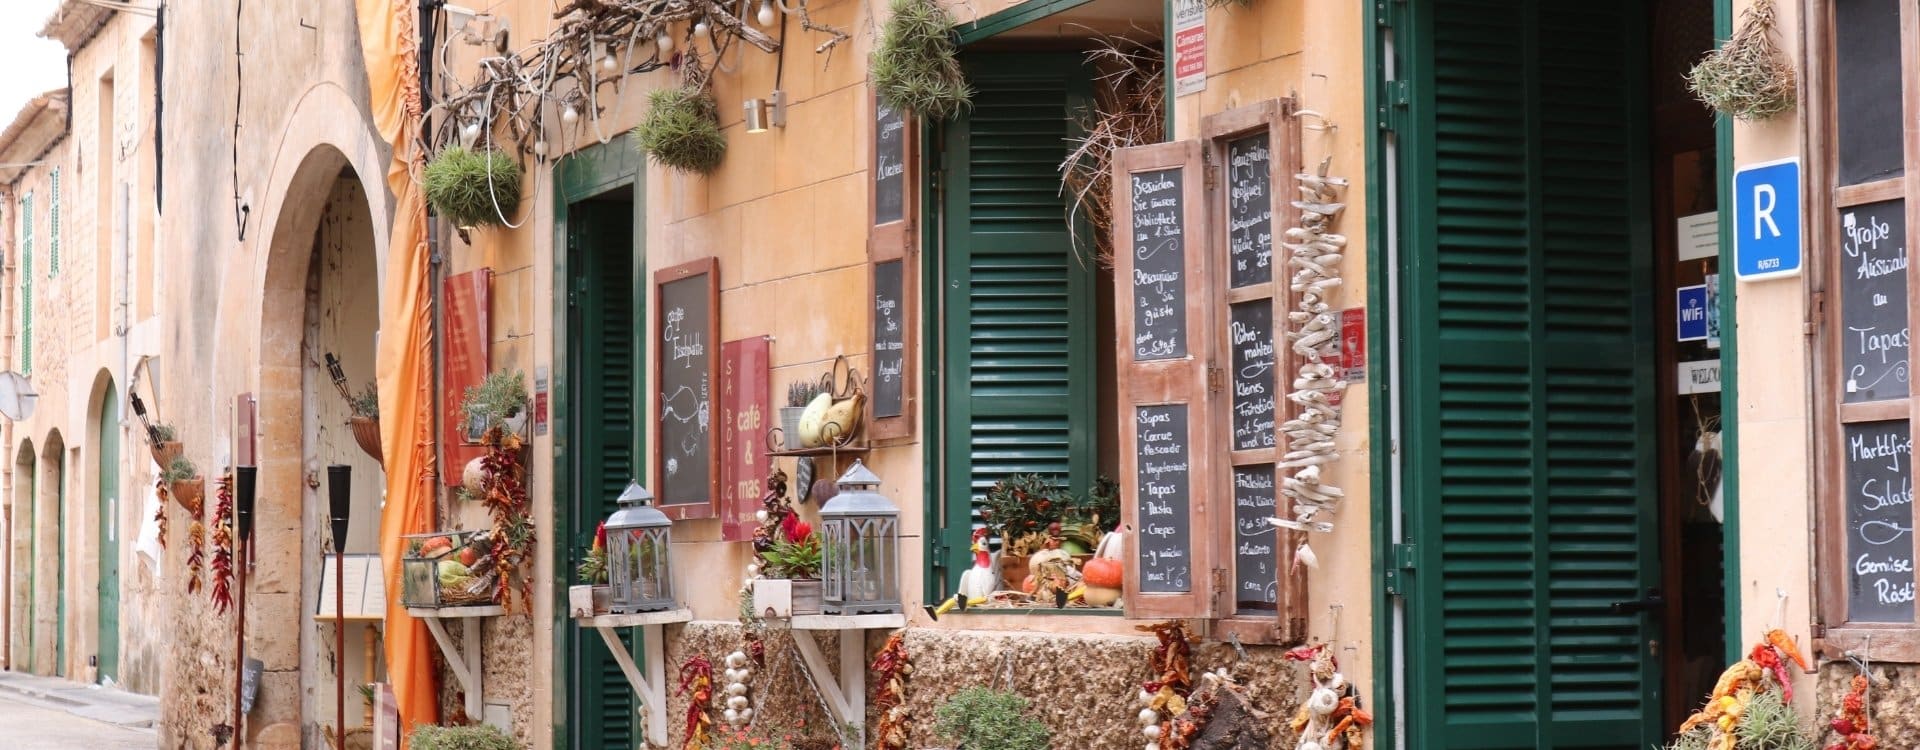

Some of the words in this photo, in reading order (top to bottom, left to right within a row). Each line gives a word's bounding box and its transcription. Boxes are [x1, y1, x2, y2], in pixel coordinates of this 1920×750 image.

[1133, 196, 1148, 211] Sie
[1754, 184, 1781, 240] R
[1757, 258, 1780, 270] R/6733
[1849, 326, 1910, 363] Tapas
[737, 404, 760, 432] café
[745, 439, 753, 464] &
[738, 479, 760, 499] mas
[1146, 482, 1176, 499] Tapas
[1147, 500, 1173, 515] Pasta
